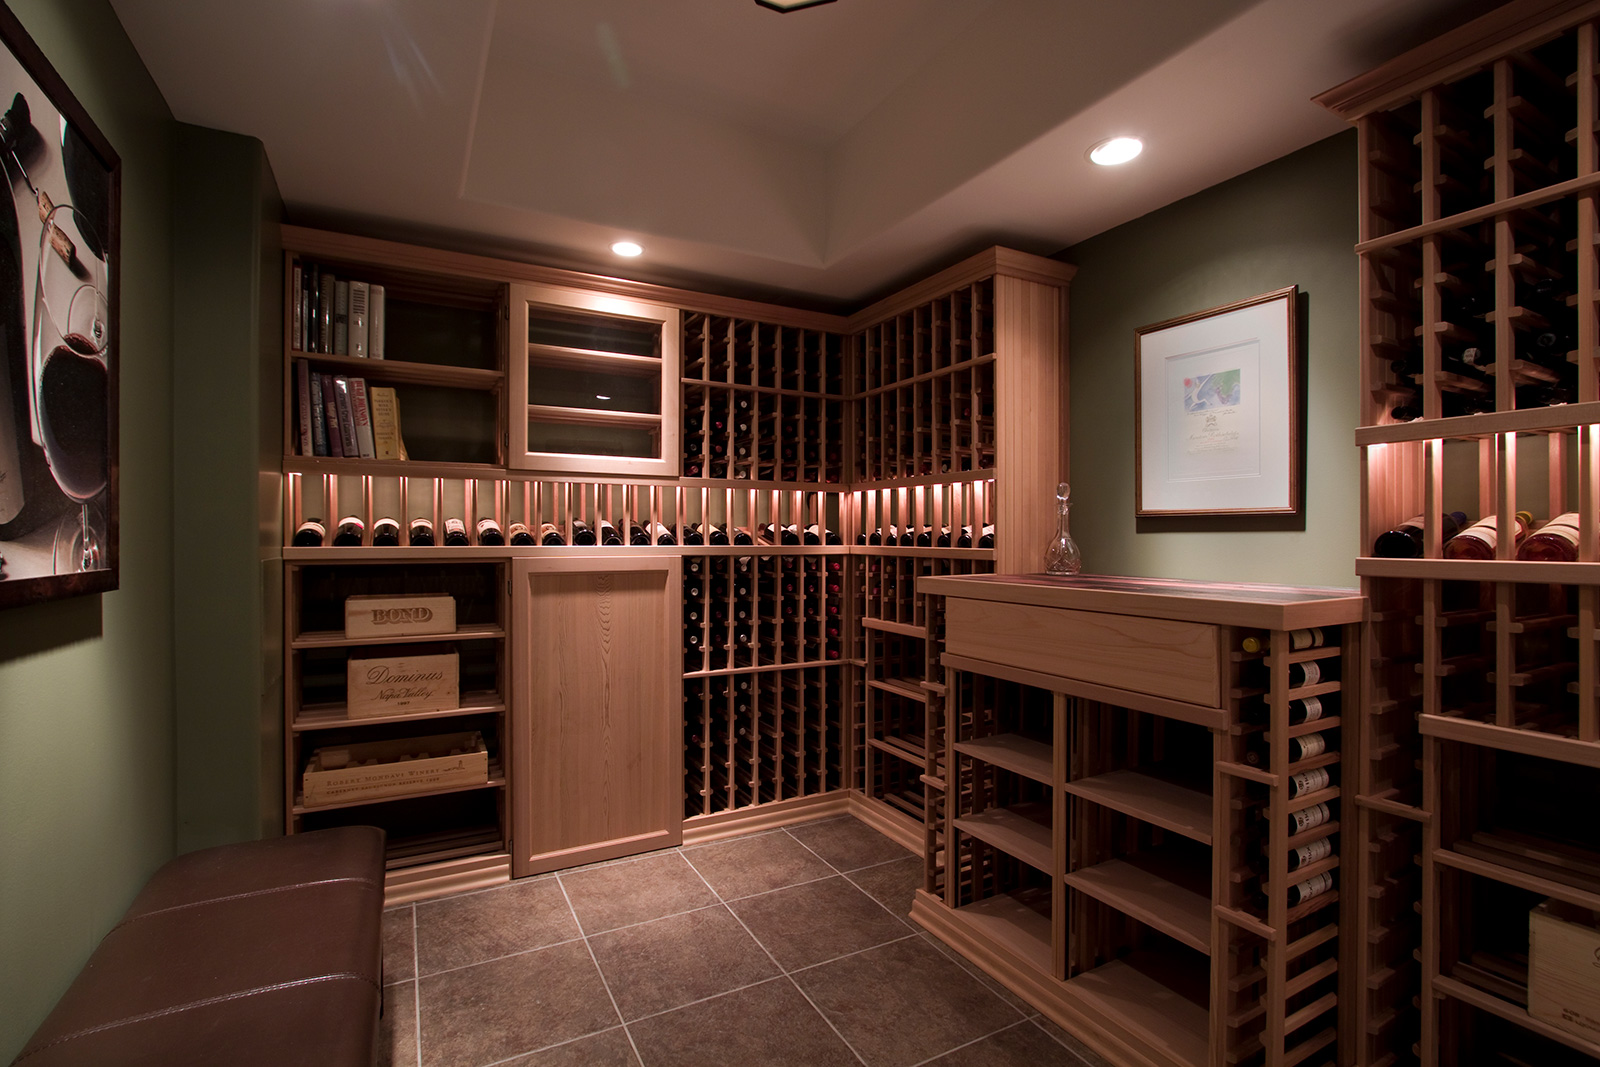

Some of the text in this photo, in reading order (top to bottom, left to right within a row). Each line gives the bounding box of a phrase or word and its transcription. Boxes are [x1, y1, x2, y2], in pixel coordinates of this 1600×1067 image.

[371, 607, 433, 625] BOND
[366, 665, 443, 685] Dominus
[370, 686, 435, 702] Napa Valley
[326, 768, 440, 787] ROBERT MONDAVI WINERY
[326, 786, 359, 795] CABERNET
